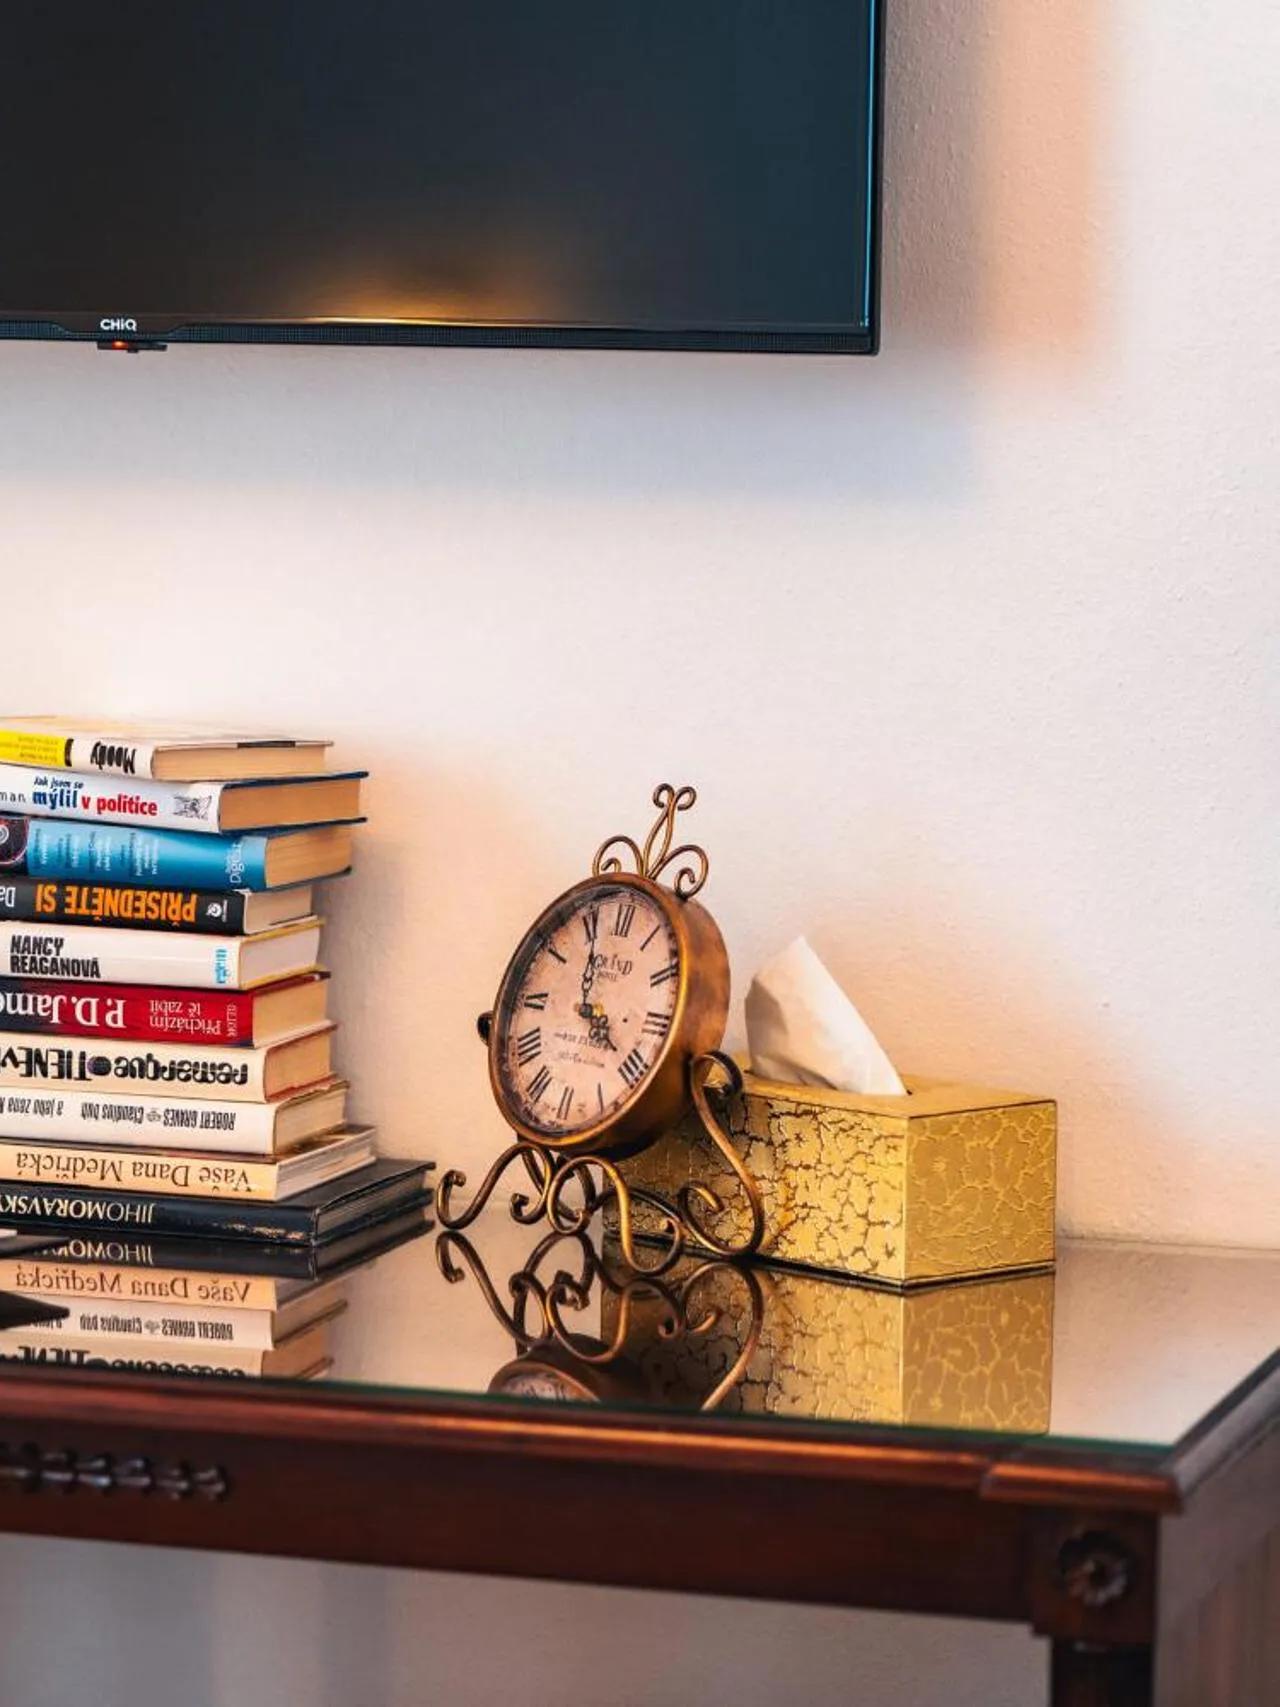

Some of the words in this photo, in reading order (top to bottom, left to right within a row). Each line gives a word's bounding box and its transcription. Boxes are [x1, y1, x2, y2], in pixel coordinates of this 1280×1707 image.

[32, 783, 78, 810] mýlil
[81, 796, 92, 810] v
[96, 791, 158, 817] politice
[35, 884, 57, 913] SI
[64, 885, 198, 926] PŘISEDNĚTE
[10, 934, 65, 956] NANCY
[10, 953, 101, 979] REAGANOVÁ
[114, 1054, 248, 1085] remarque
[163, 1108, 198, 1128] GRAVES
[200, 1111, 236, 1130] ROBERT
[15, 1153, 123, 1183] Medřická
[132, 1163, 190, 1187] Dana
[199, 1167, 254, 1195] Vaše
